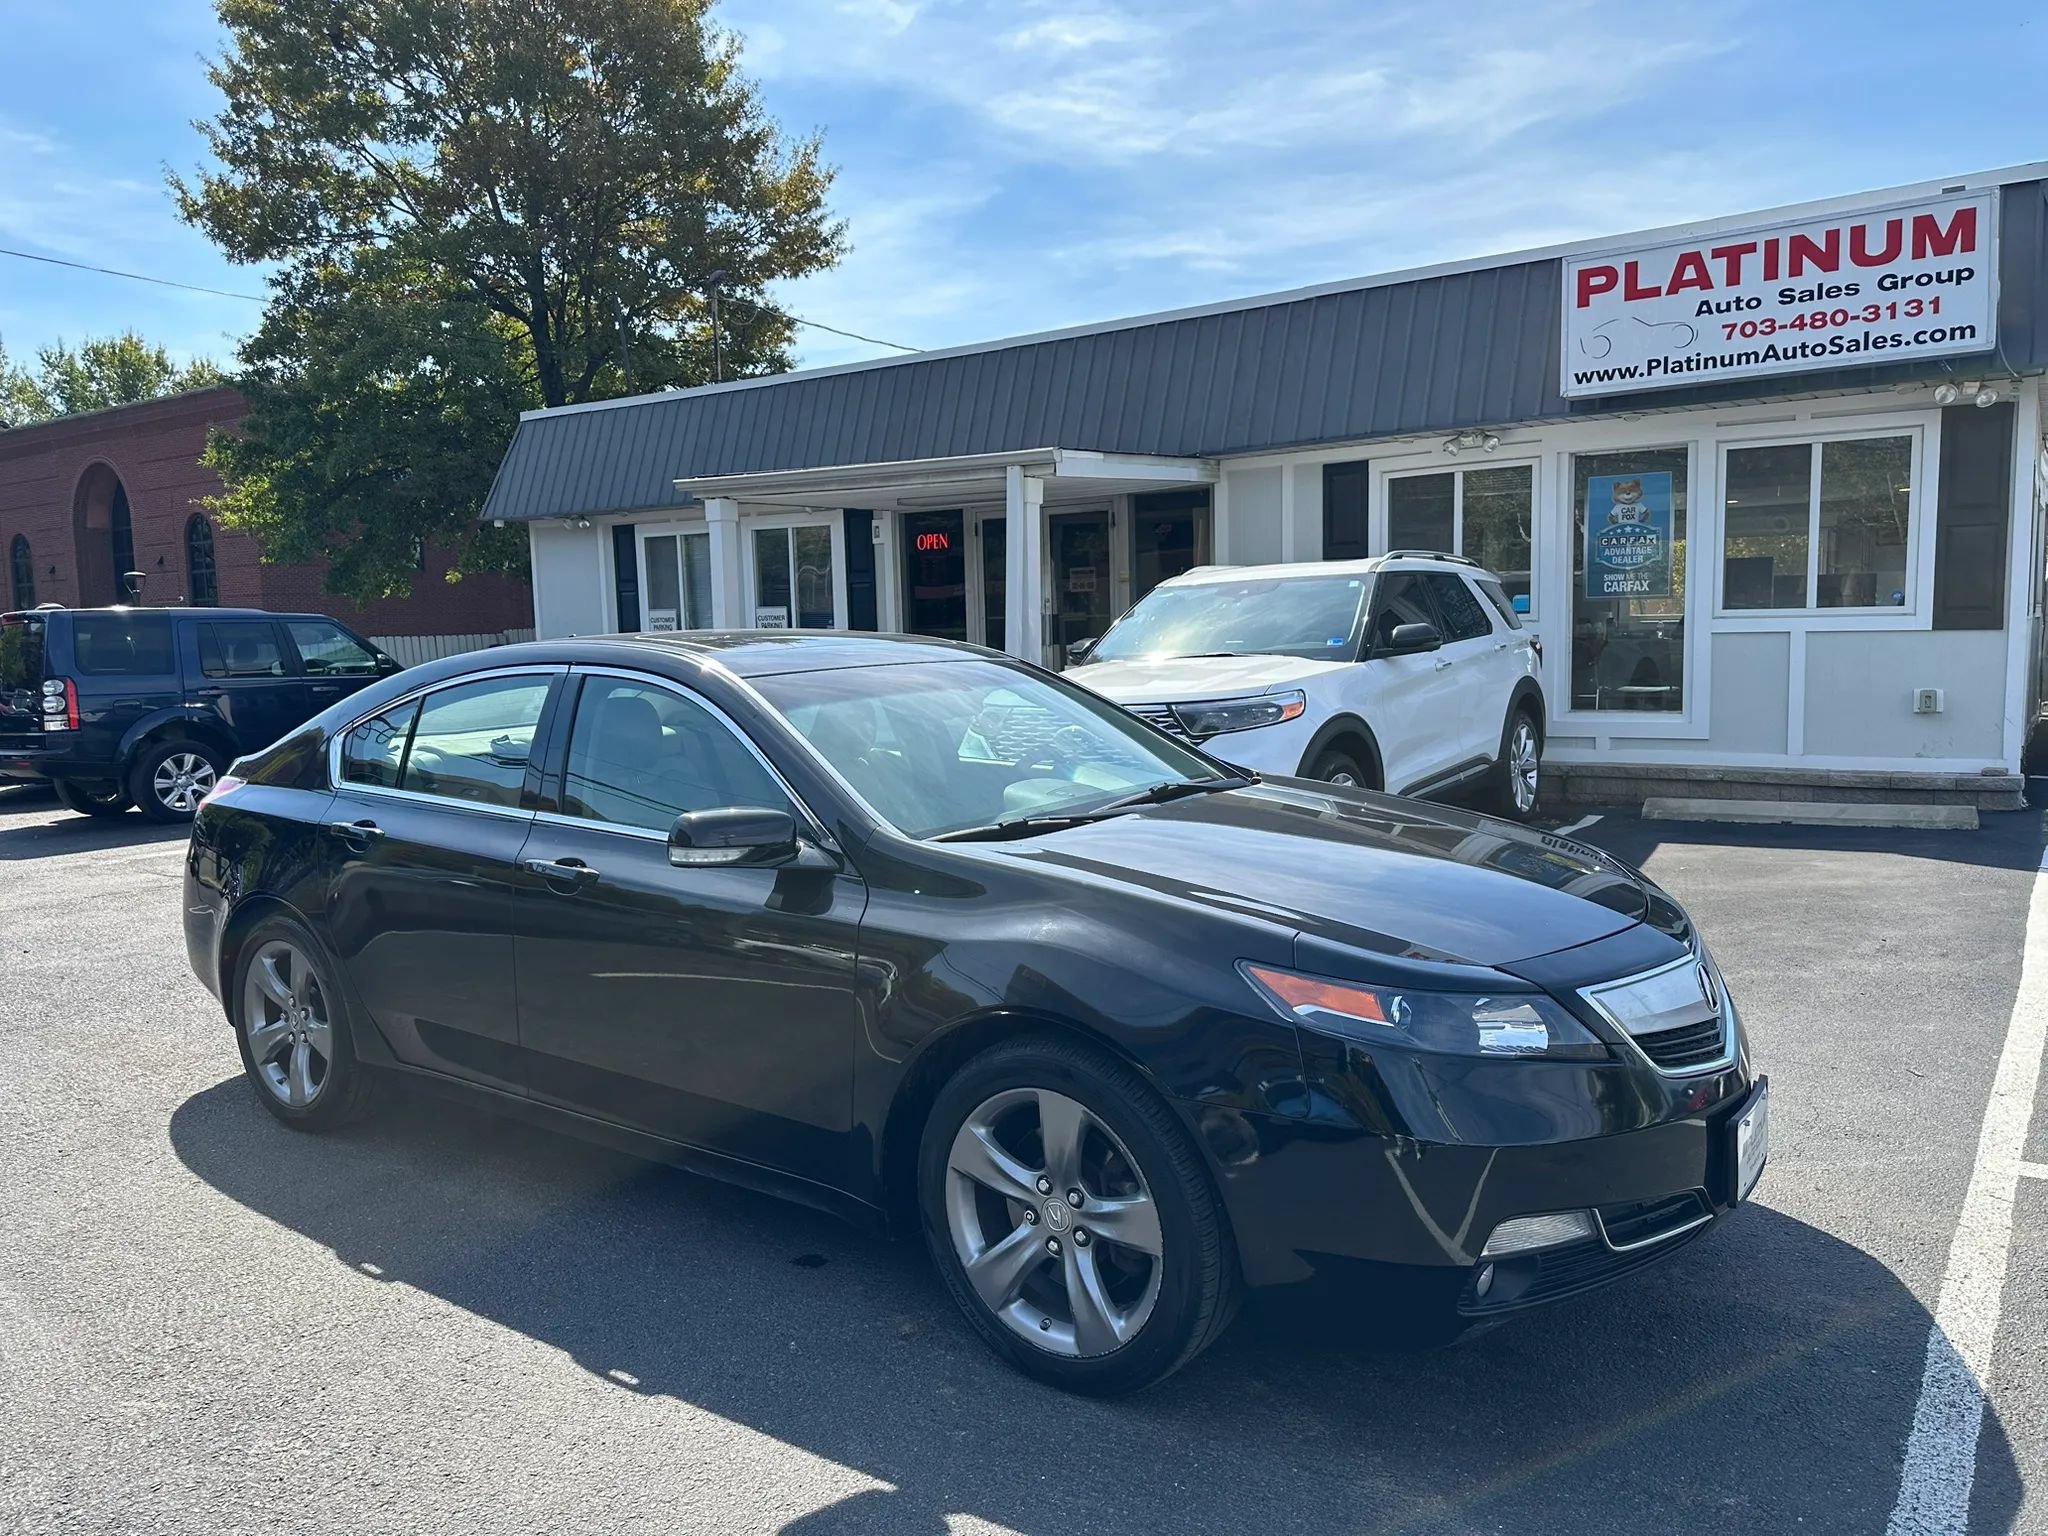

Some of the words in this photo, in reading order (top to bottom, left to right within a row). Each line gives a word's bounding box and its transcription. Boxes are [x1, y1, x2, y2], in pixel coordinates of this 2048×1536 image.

[1576, 206, 1978, 309] PLATINUM
[1695, 295, 1762, 318] Auto
[1777, 281, 1861, 306] Sales
[1877, 266, 1975, 292] Group
[1721, 295, 1942, 341] 703-480-3131
[1573, 322, 1977, 386] www.PlatinumAutoSales.com
[1621, 506, 1636, 514] CAR
[916, 532, 949, 552] OPEN
[1601, 535, 1656, 546] CARFAX
[1604, 547, 1652, 556] ADVANTAGE
[1612, 556, 1644, 564] DEALER
[1604, 581, 1650, 593] CARFAX
[650, 616, 675, 624] CUSTOMER
[758, 614, 786, 622] CUSTOMER
[653, 623, 673, 631] PARKING
